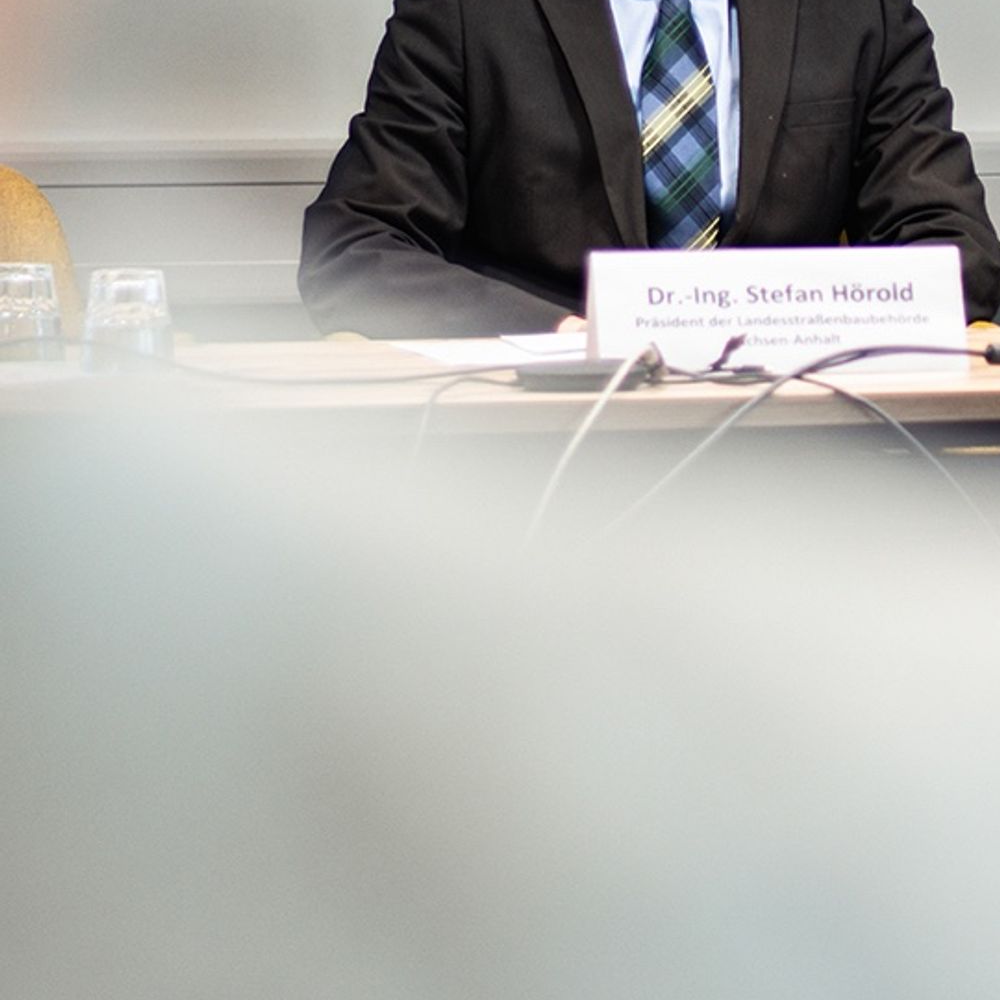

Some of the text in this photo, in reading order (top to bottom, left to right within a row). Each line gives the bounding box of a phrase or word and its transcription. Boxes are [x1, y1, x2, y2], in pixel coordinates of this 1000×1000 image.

[745, 284, 824, 304] Stefan
[831, 281, 914, 303] Hörold
[635, 316, 704, 328] Präsident
[708, 316, 732, 328] der
